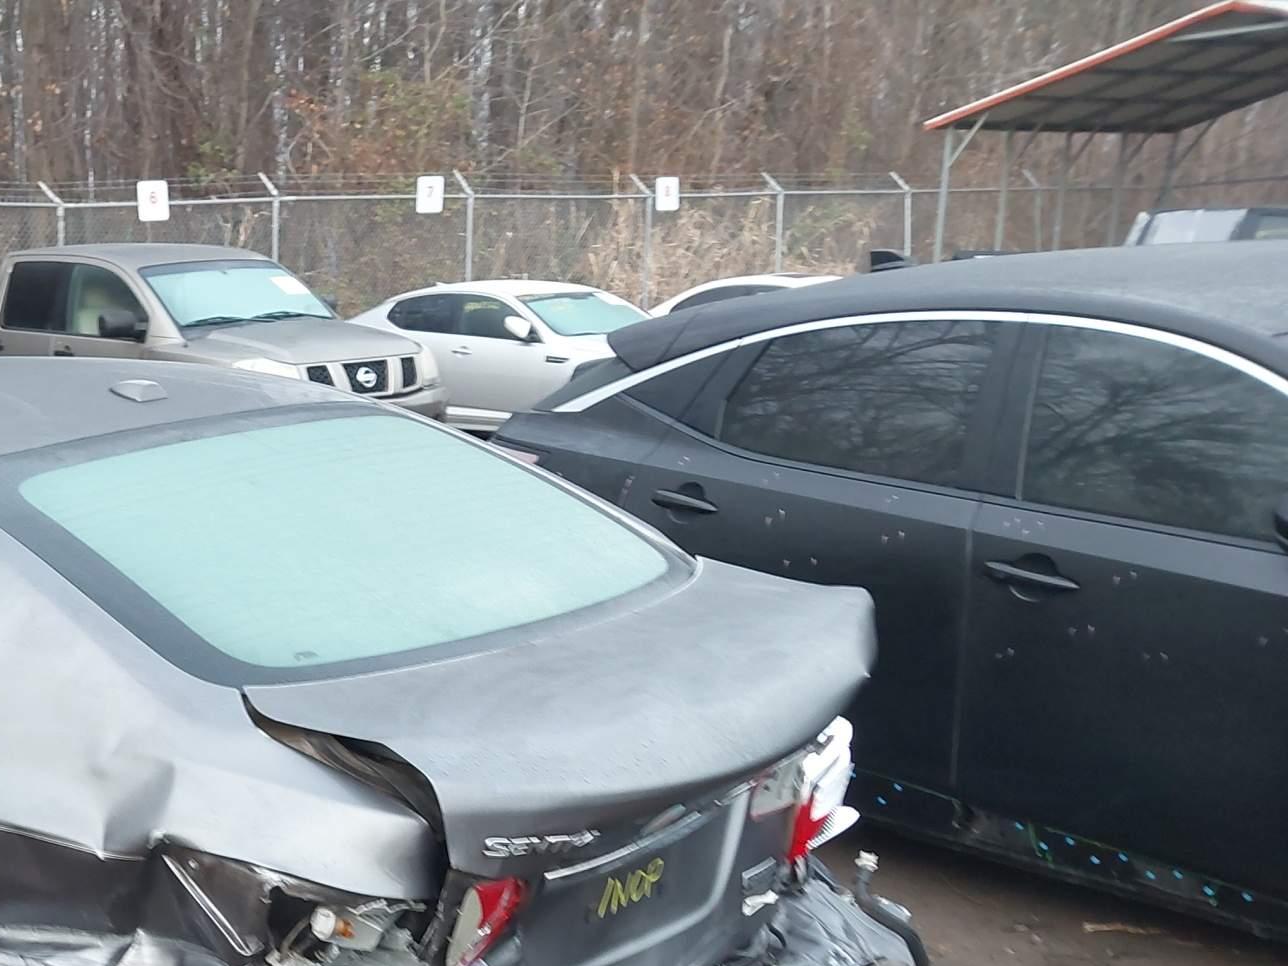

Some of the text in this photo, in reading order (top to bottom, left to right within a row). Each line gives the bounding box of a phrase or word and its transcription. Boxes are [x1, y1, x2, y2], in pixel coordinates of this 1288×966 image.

[149, 191, 159, 205] 6
[425, 185, 435, 199] 7
[481, 829, 601, 857] SENT
